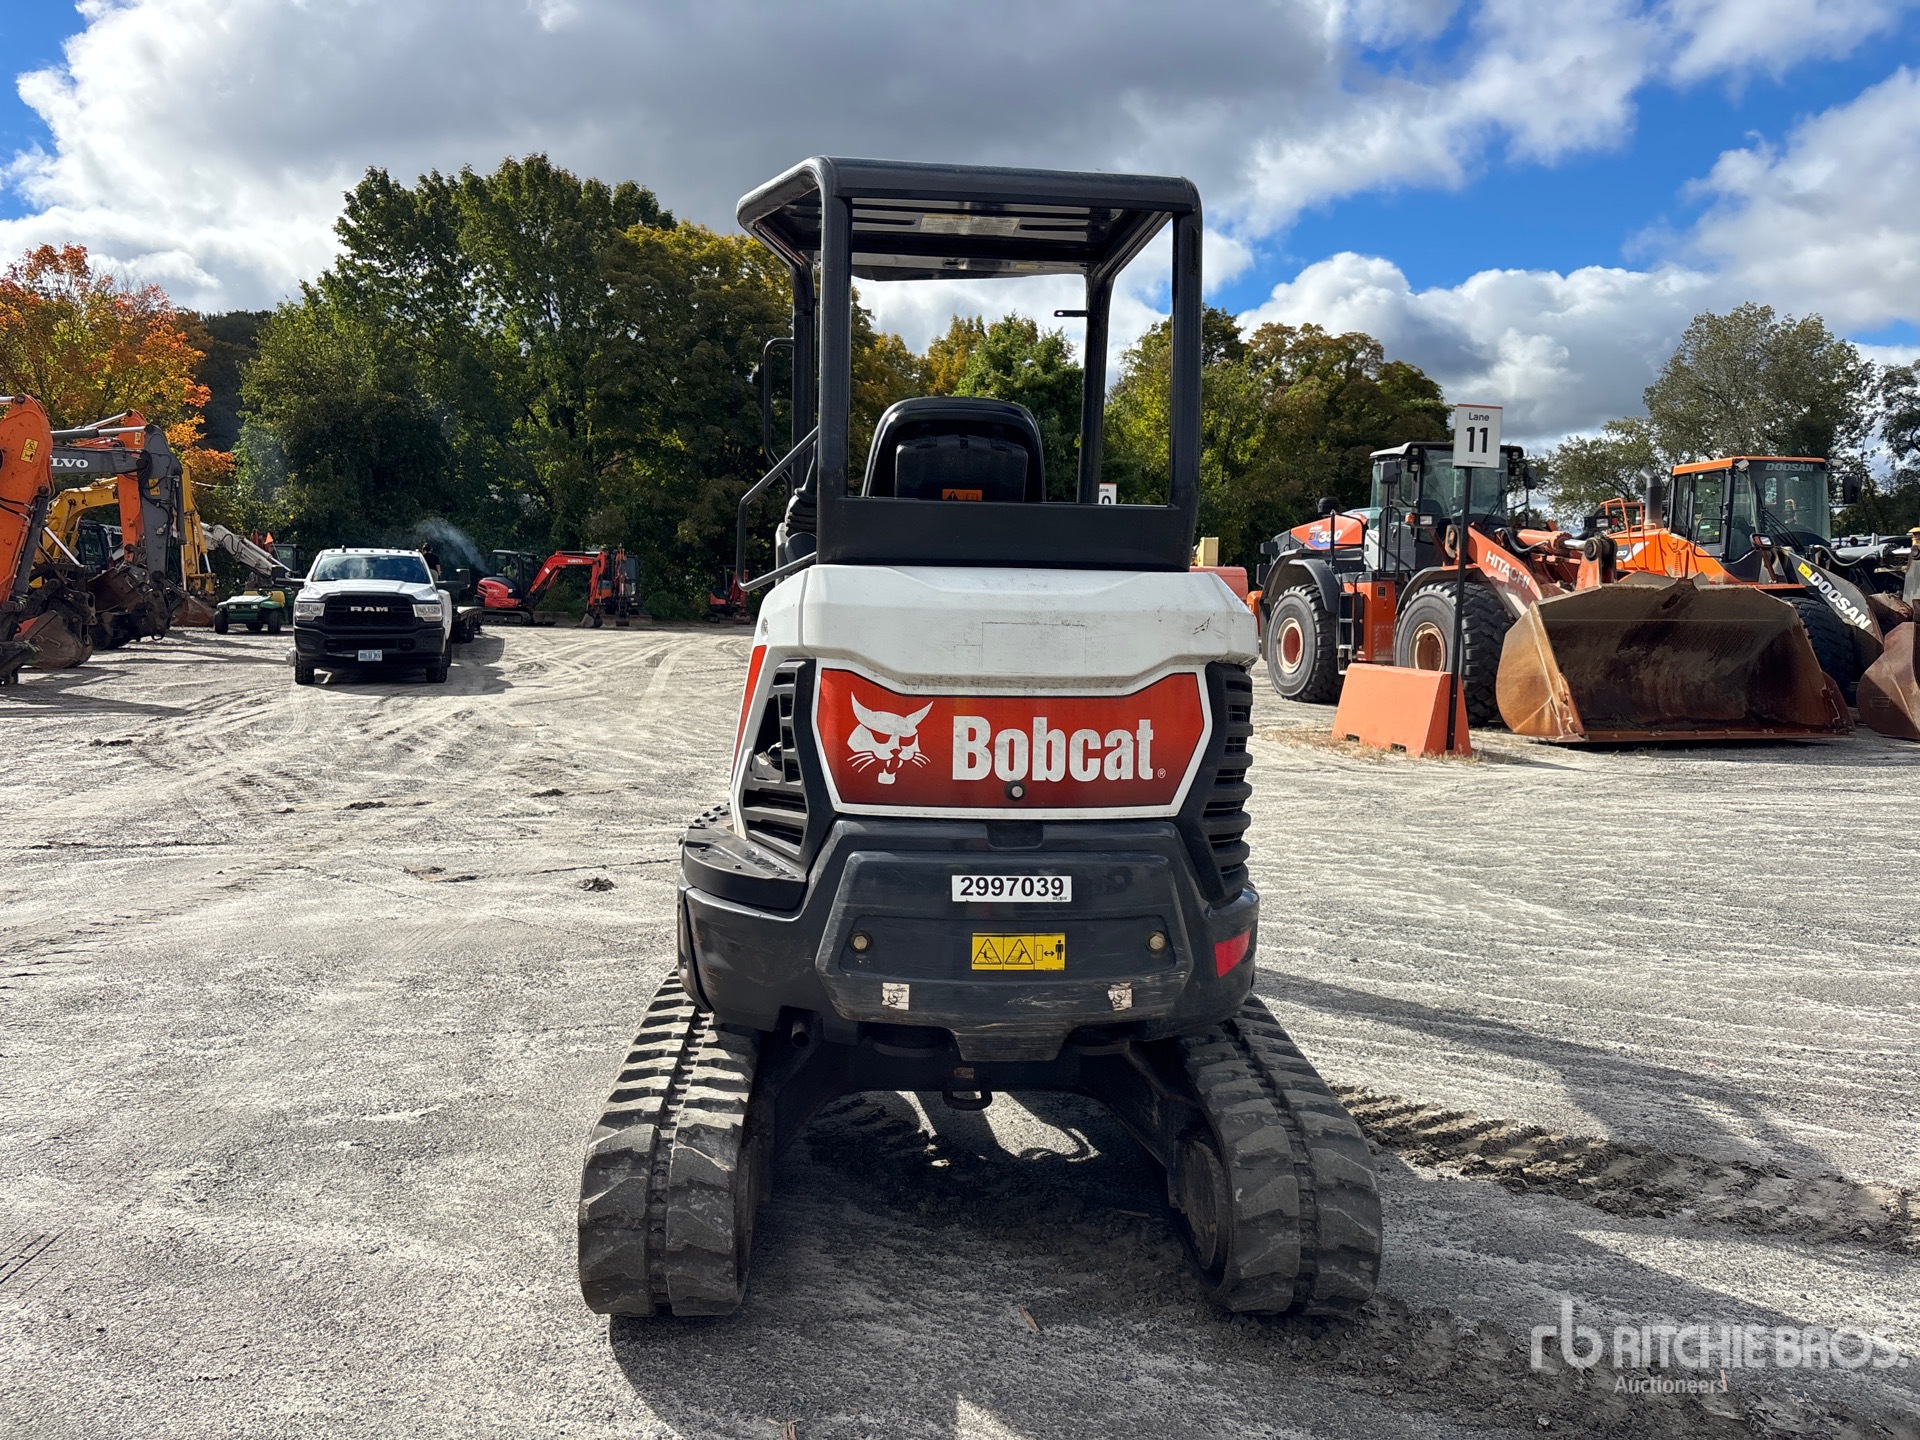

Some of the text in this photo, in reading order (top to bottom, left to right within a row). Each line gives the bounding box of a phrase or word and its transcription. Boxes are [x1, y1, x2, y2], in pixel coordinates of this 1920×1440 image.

[1468, 411, 1489, 421] Lane
[1466, 426, 1488, 453] 11
[50, 457, 89, 469] LVO
[1765, 463, 1814, 472] DOOSAN
[1485, 551, 1530, 589] HITACHI
[1808, 572, 1871, 630] DOOSAN
[952, 715, 1154, 782] Bobcat
[960, 877, 1064, 897] 2997039
